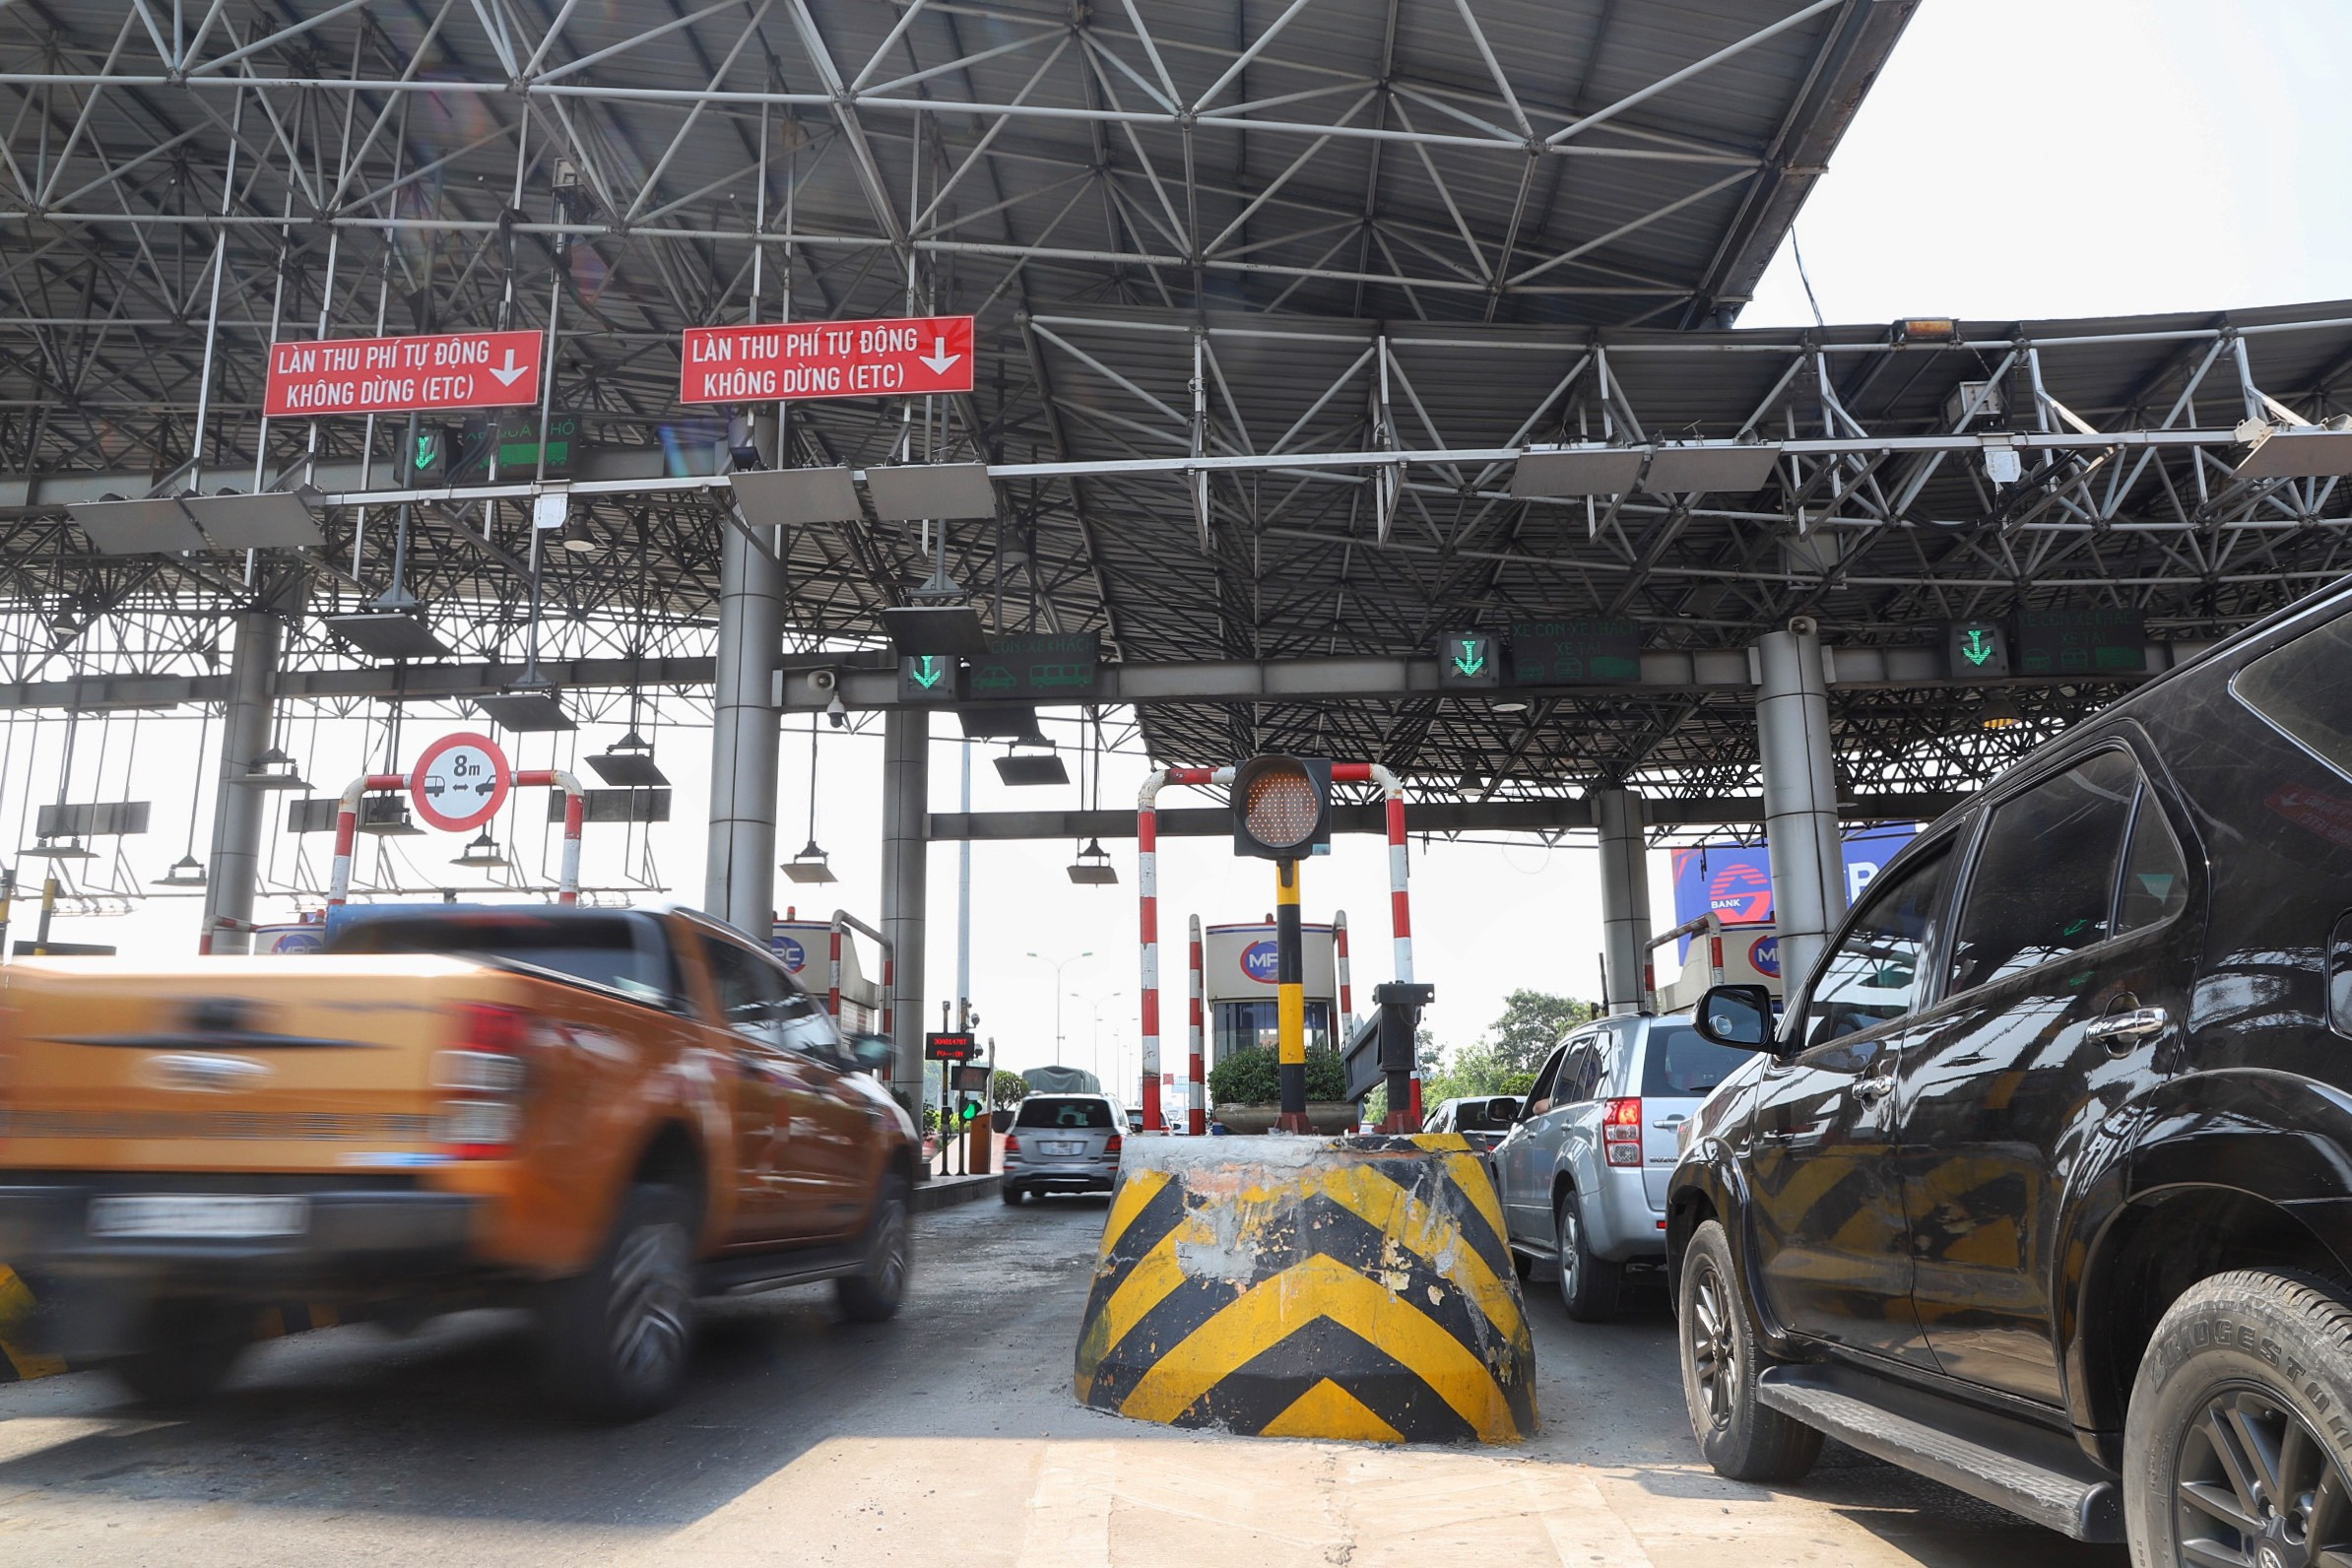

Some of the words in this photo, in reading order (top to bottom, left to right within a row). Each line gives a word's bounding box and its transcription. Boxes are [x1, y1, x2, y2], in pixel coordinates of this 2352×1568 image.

[278, 345, 316, 374] LÀN
[322, 347, 359, 372] THU
[365, 339, 401, 369] PHÍ
[404, 343, 430, 372] TỰ
[434, 338, 490, 368] ĐỘNG
[692, 332, 732, 362] LÀN
[738, 334, 779, 359] THU
[786, 326, 822, 358] PHÍ
[825, 330, 854, 359] TỰ
[859, 325, 918, 358] ĐỘNG
[286, 379, 355, 408] KHÔNG
[360, 374, 415, 405] DỪNG
[422, 373, 475, 402] (ETC)
[703, 367, 776, 397] KHÔNG
[783, 362, 841, 393] DỪNG
[848, 362, 904, 390] (ETC)
[453, 754, 481, 777] 8m
[1711, 898, 1740, 909] BANK
